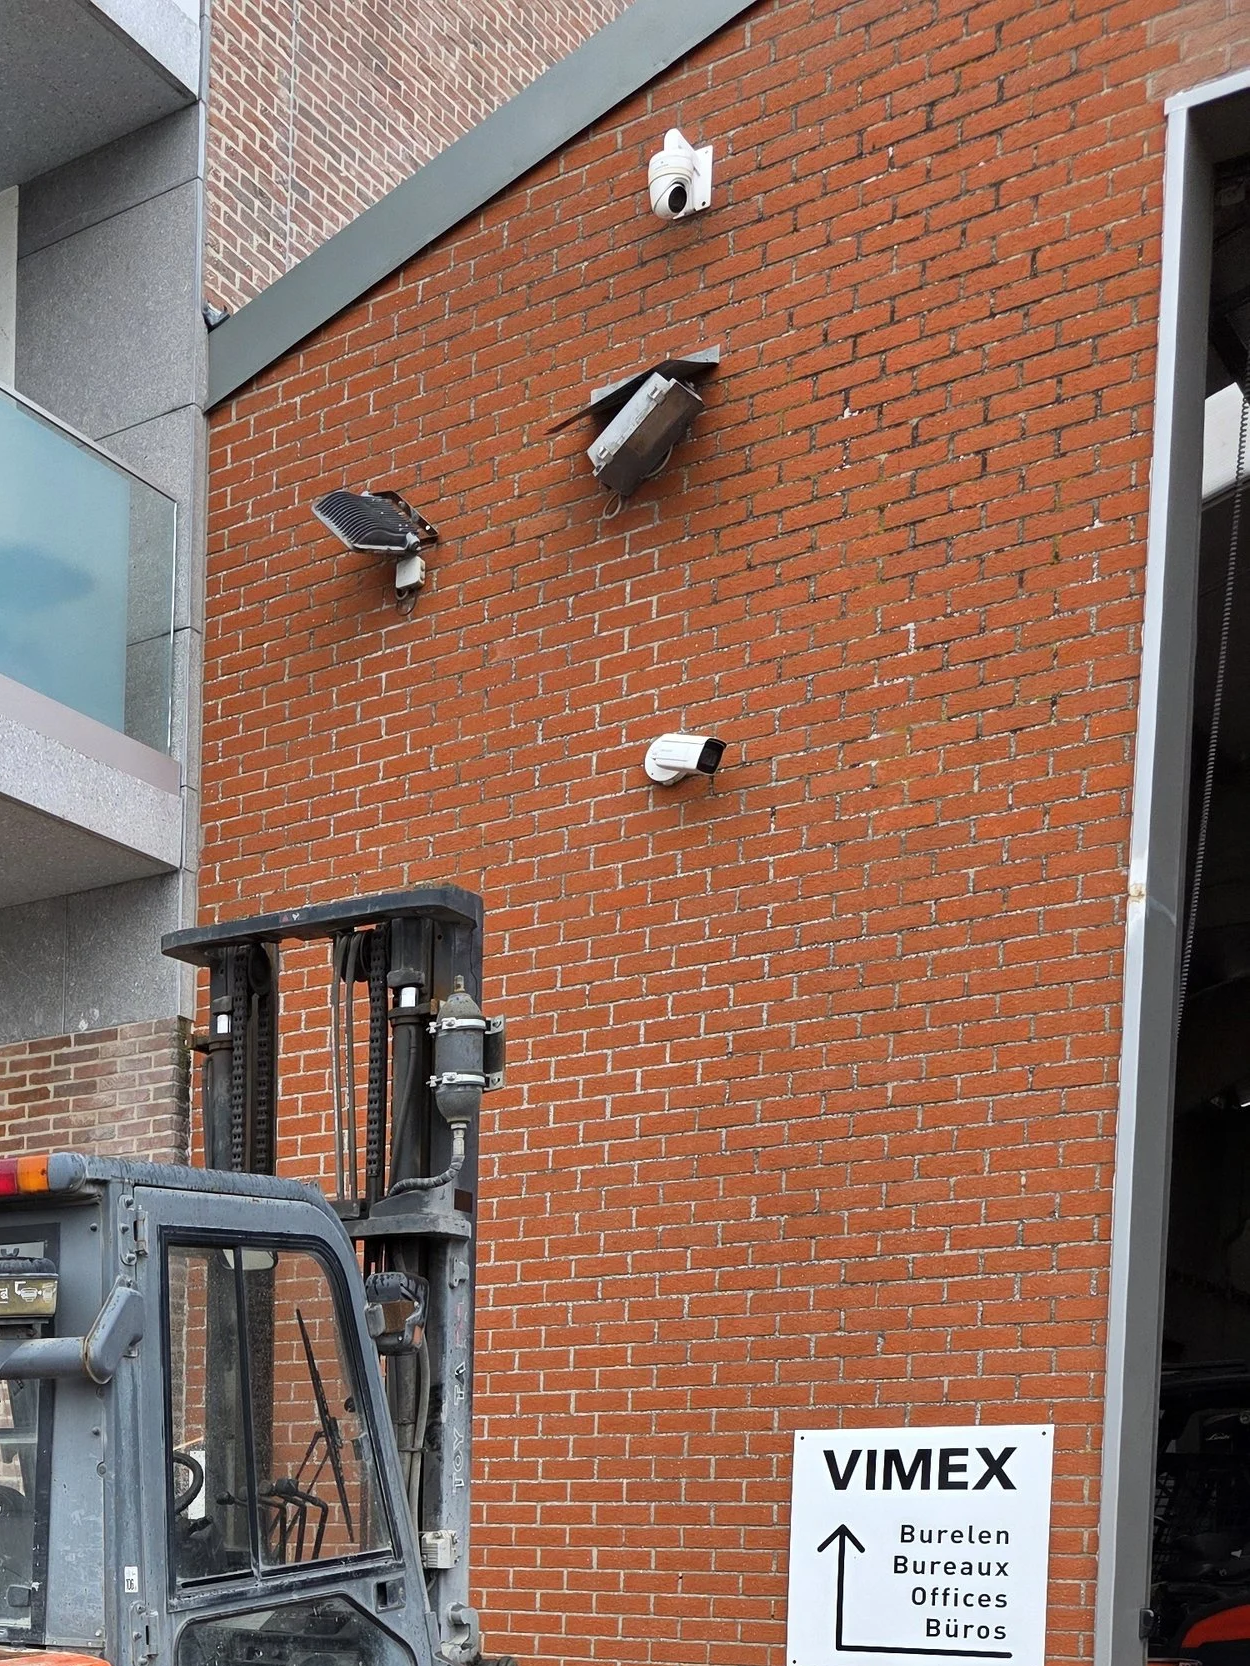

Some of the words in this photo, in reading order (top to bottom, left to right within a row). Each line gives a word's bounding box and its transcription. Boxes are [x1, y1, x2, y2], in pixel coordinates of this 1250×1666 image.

[823, 1447, 1017, 1490] VIMEX
[900, 1525, 1009, 1544] Burelen
[893, 1556, 1009, 1576] Bureaux
[911, 1587, 1007, 1608] Offices
[926, 1618, 1007, 1639] Büros
